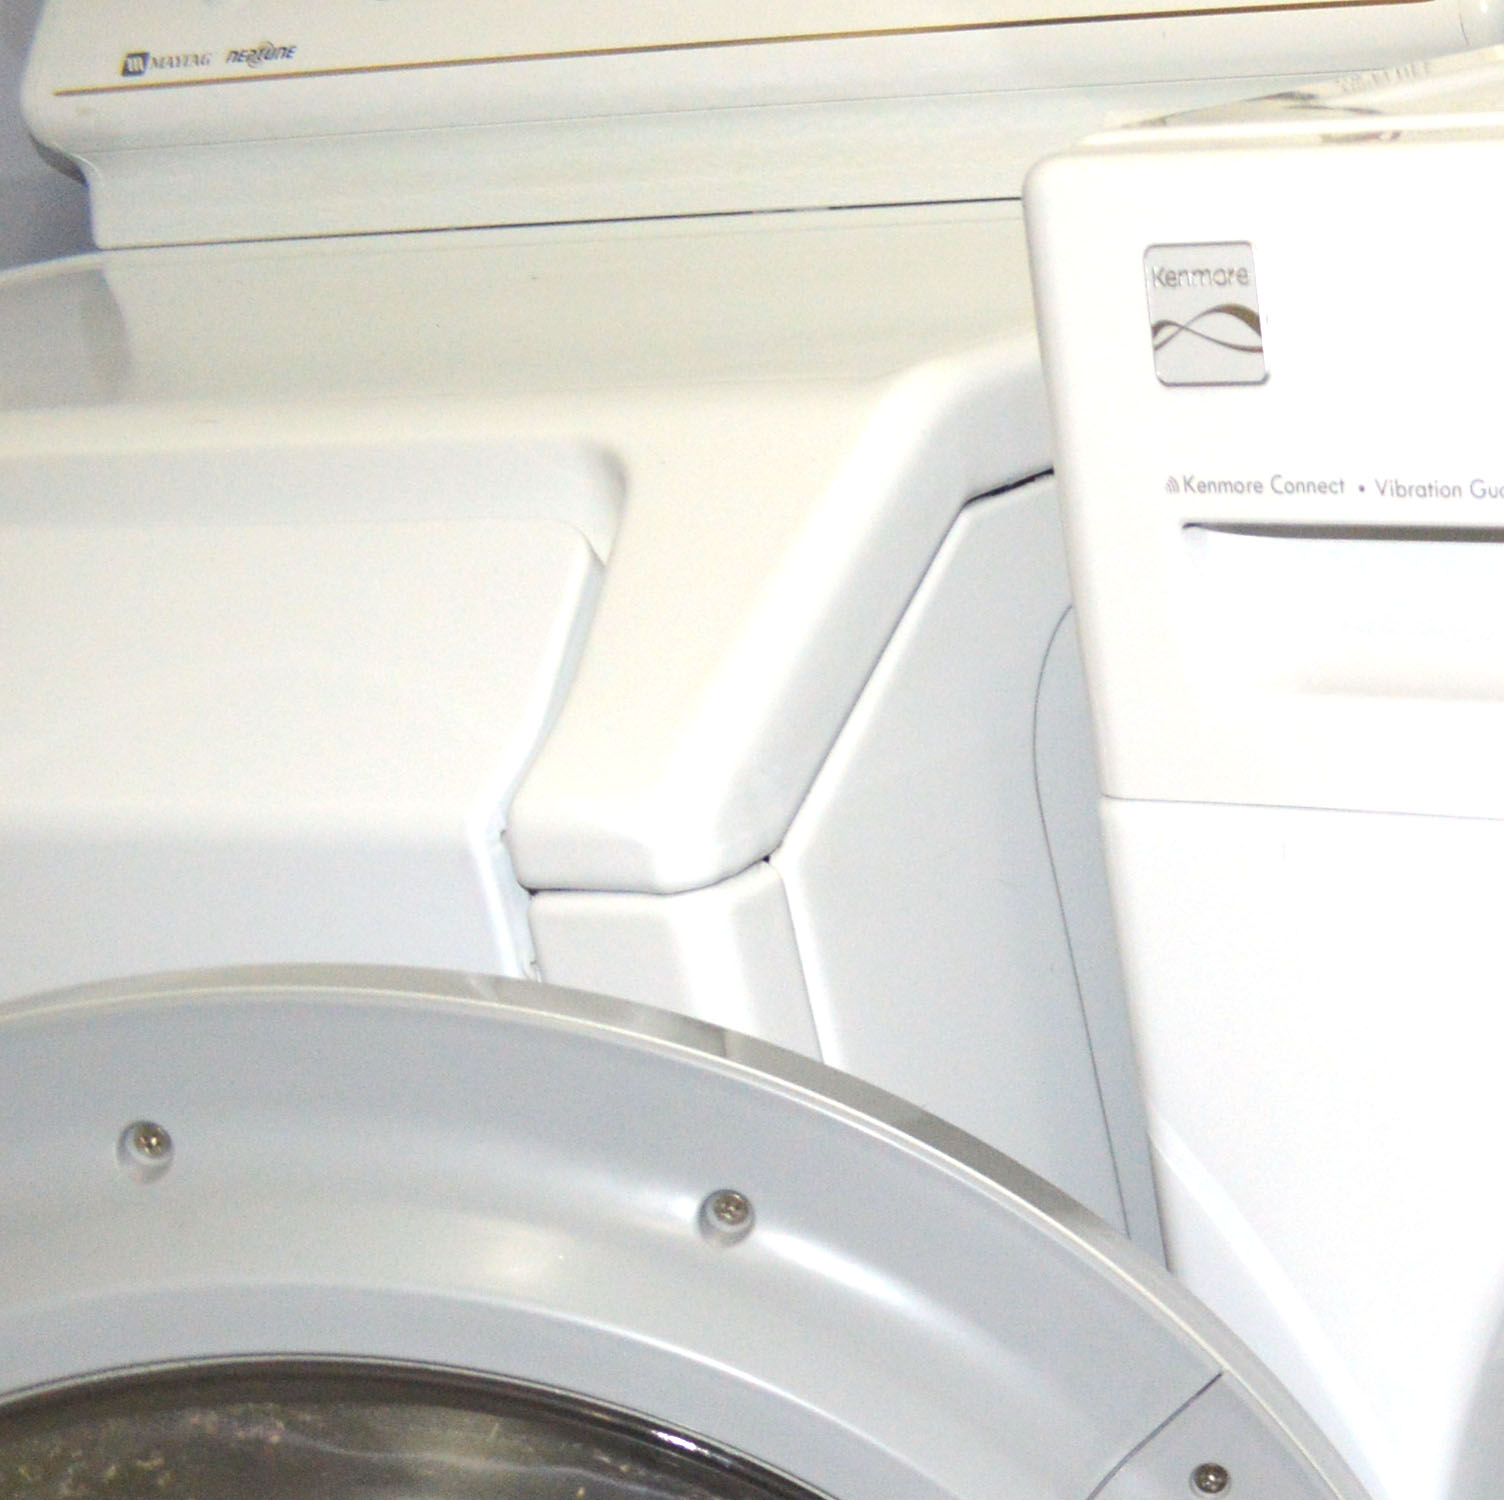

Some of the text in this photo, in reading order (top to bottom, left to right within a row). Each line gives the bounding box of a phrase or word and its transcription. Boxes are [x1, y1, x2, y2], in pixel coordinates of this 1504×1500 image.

[150, 53, 212, 69] MAYTAG
[1152, 264, 1249, 289] Kenmore
[1183, 475, 1264, 495] Kenmore
[1270, 475, 1345, 495] Connect
[1375, 478, 1462, 500] Vibration
